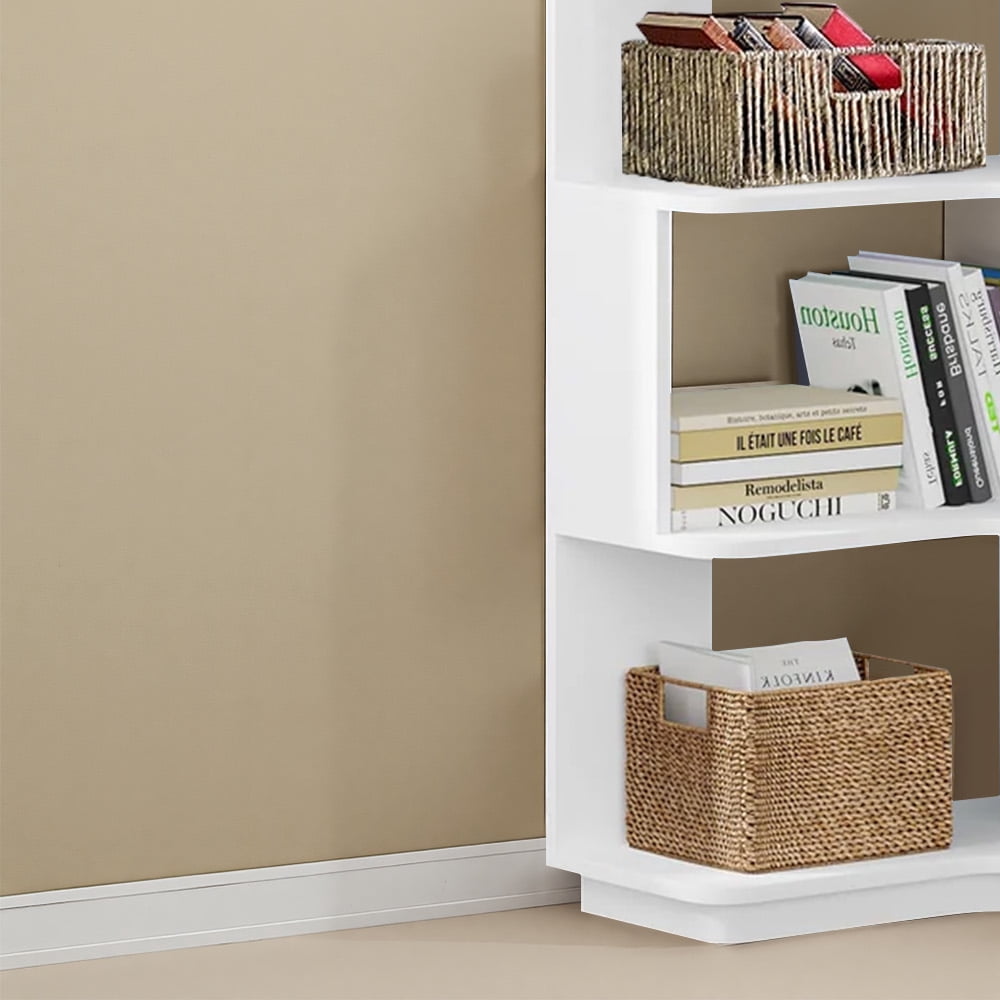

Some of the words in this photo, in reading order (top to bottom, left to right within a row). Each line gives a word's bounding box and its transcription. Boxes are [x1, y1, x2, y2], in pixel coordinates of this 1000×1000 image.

[736, 436, 747, 451] IL
[749, 430, 775, 450] ÉTAIT
[777, 430, 798, 448] UNE
[800, 428, 822, 446] FOIS
[823, 426, 836, 444] LE
[837, 424, 863, 442] CAFÉ
[745, 478, 824, 497] Remodelista
[717, 496, 842, 527] NOGUCHI
